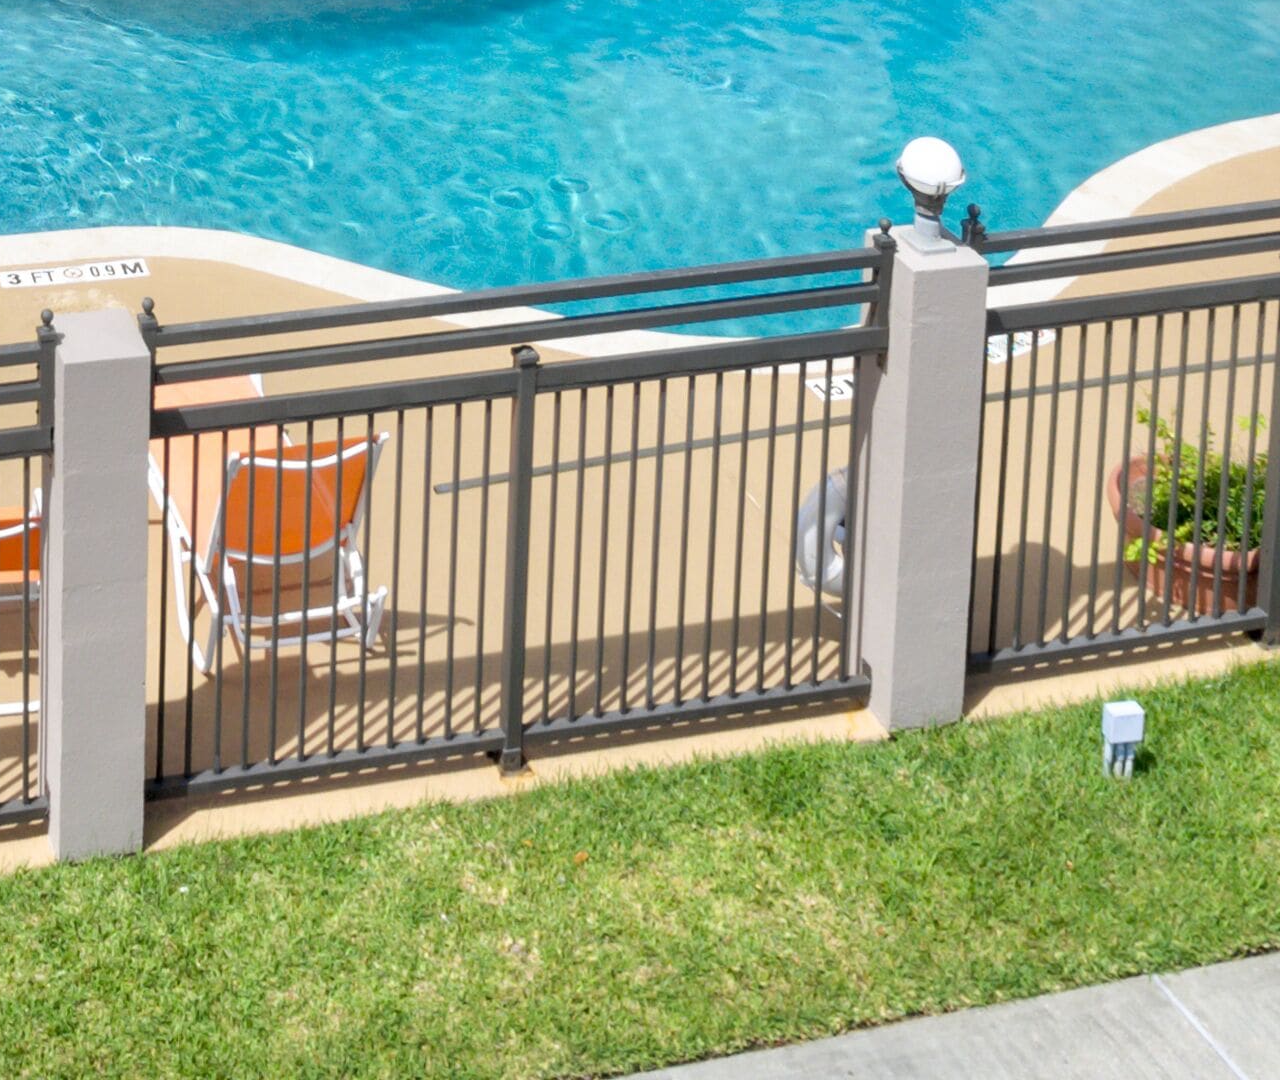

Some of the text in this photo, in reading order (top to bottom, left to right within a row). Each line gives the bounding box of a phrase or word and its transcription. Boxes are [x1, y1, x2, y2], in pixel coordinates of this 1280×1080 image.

[6, 273, 21, 285] 3
[31, 270, 54, 284] FT
[121, 261, 144, 275] M
